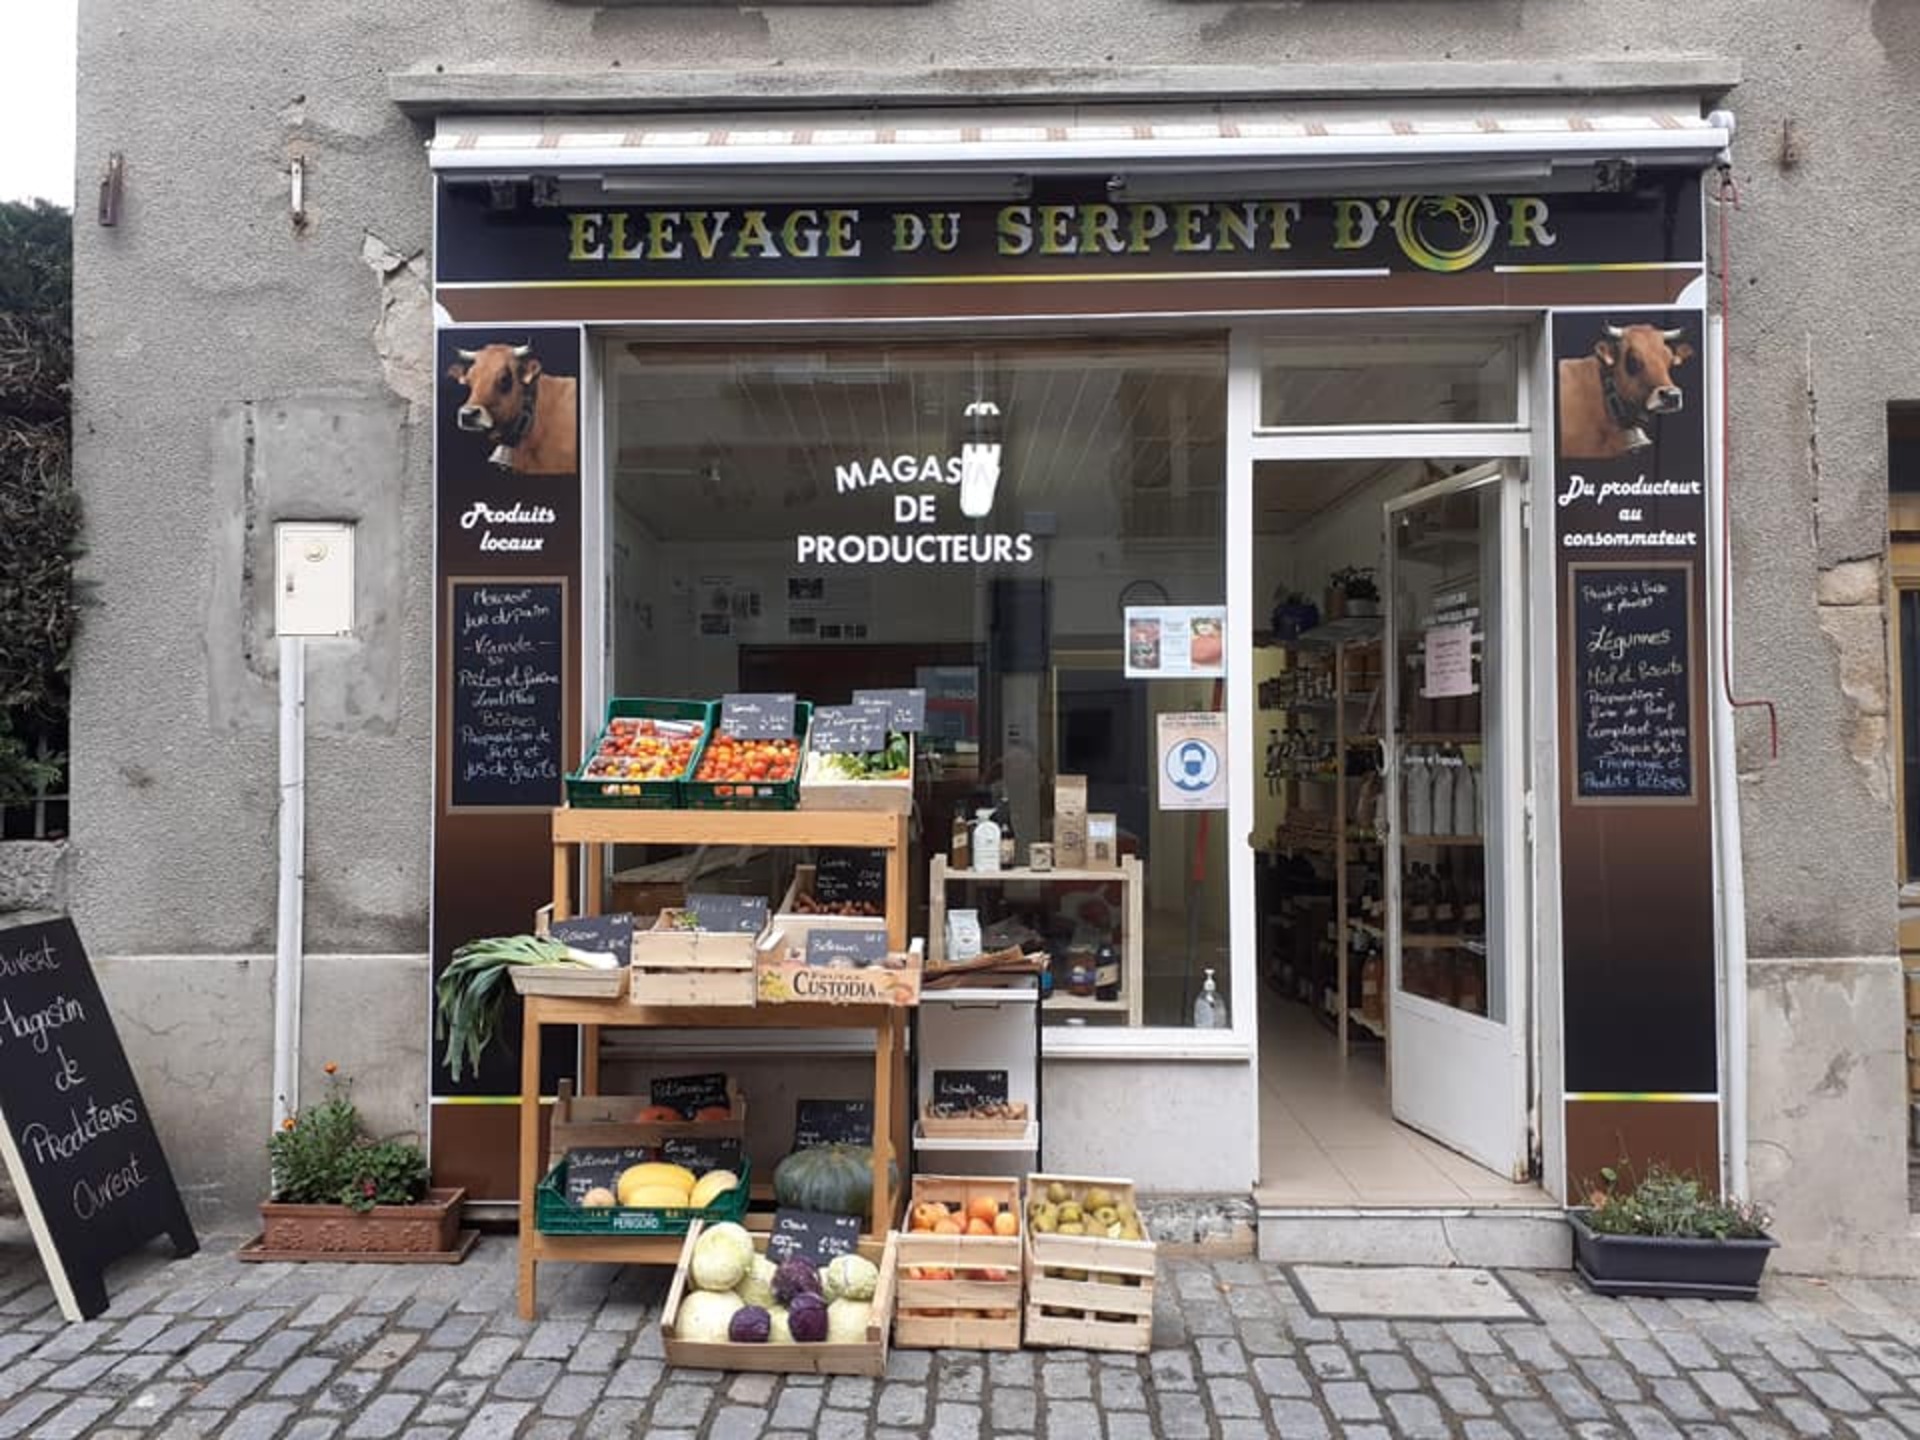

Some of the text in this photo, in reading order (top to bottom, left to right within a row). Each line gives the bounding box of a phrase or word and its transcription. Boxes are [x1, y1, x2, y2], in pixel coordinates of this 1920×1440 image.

[567, 208, 861, 260] ELEVAGE
[892, 212, 961, 252] DU
[998, 204, 1301, 255] SERPENT
[1558, 475, 1702, 506] Du producteur
[460, 502, 556, 530] Produits
[894, 495, 937, 523] DE
[1617, 505, 1643, 522] au
[479, 530, 545, 552] locaux
[797, 533, 1034, 563] PRODUCTEURS
[1562, 529, 1698, 548] consommateur
[1586, 625, 1672, 660] Légumes
[792, 970, 877, 996] CUSTODIA
[55, 1044, 87, 1092] de
